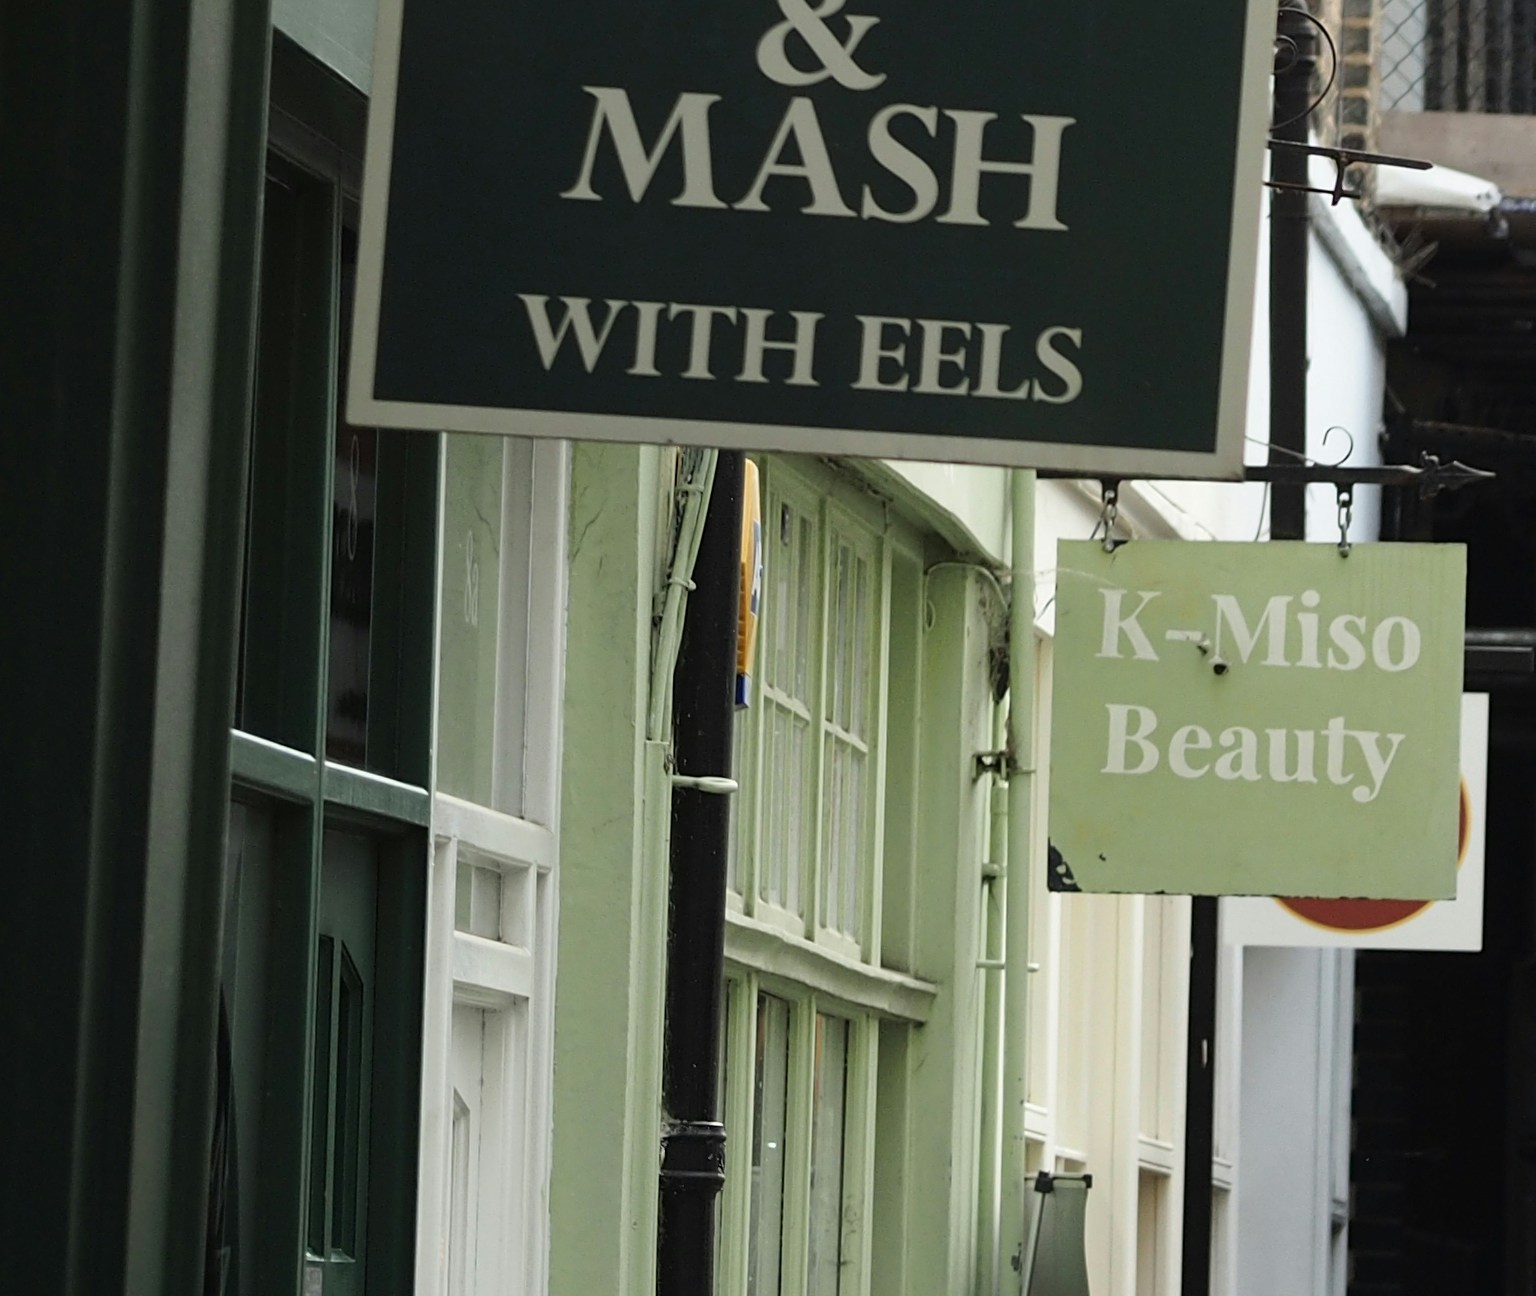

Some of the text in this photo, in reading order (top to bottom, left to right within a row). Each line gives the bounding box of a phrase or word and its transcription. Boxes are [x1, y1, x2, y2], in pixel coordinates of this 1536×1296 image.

[558, 84, 1078, 233] MASH
[516, 292, 1084, 407] WITH EELS
[1094, 587, 1423, 674] K-Miso
[1100, 702, 1407, 805] Beauty
